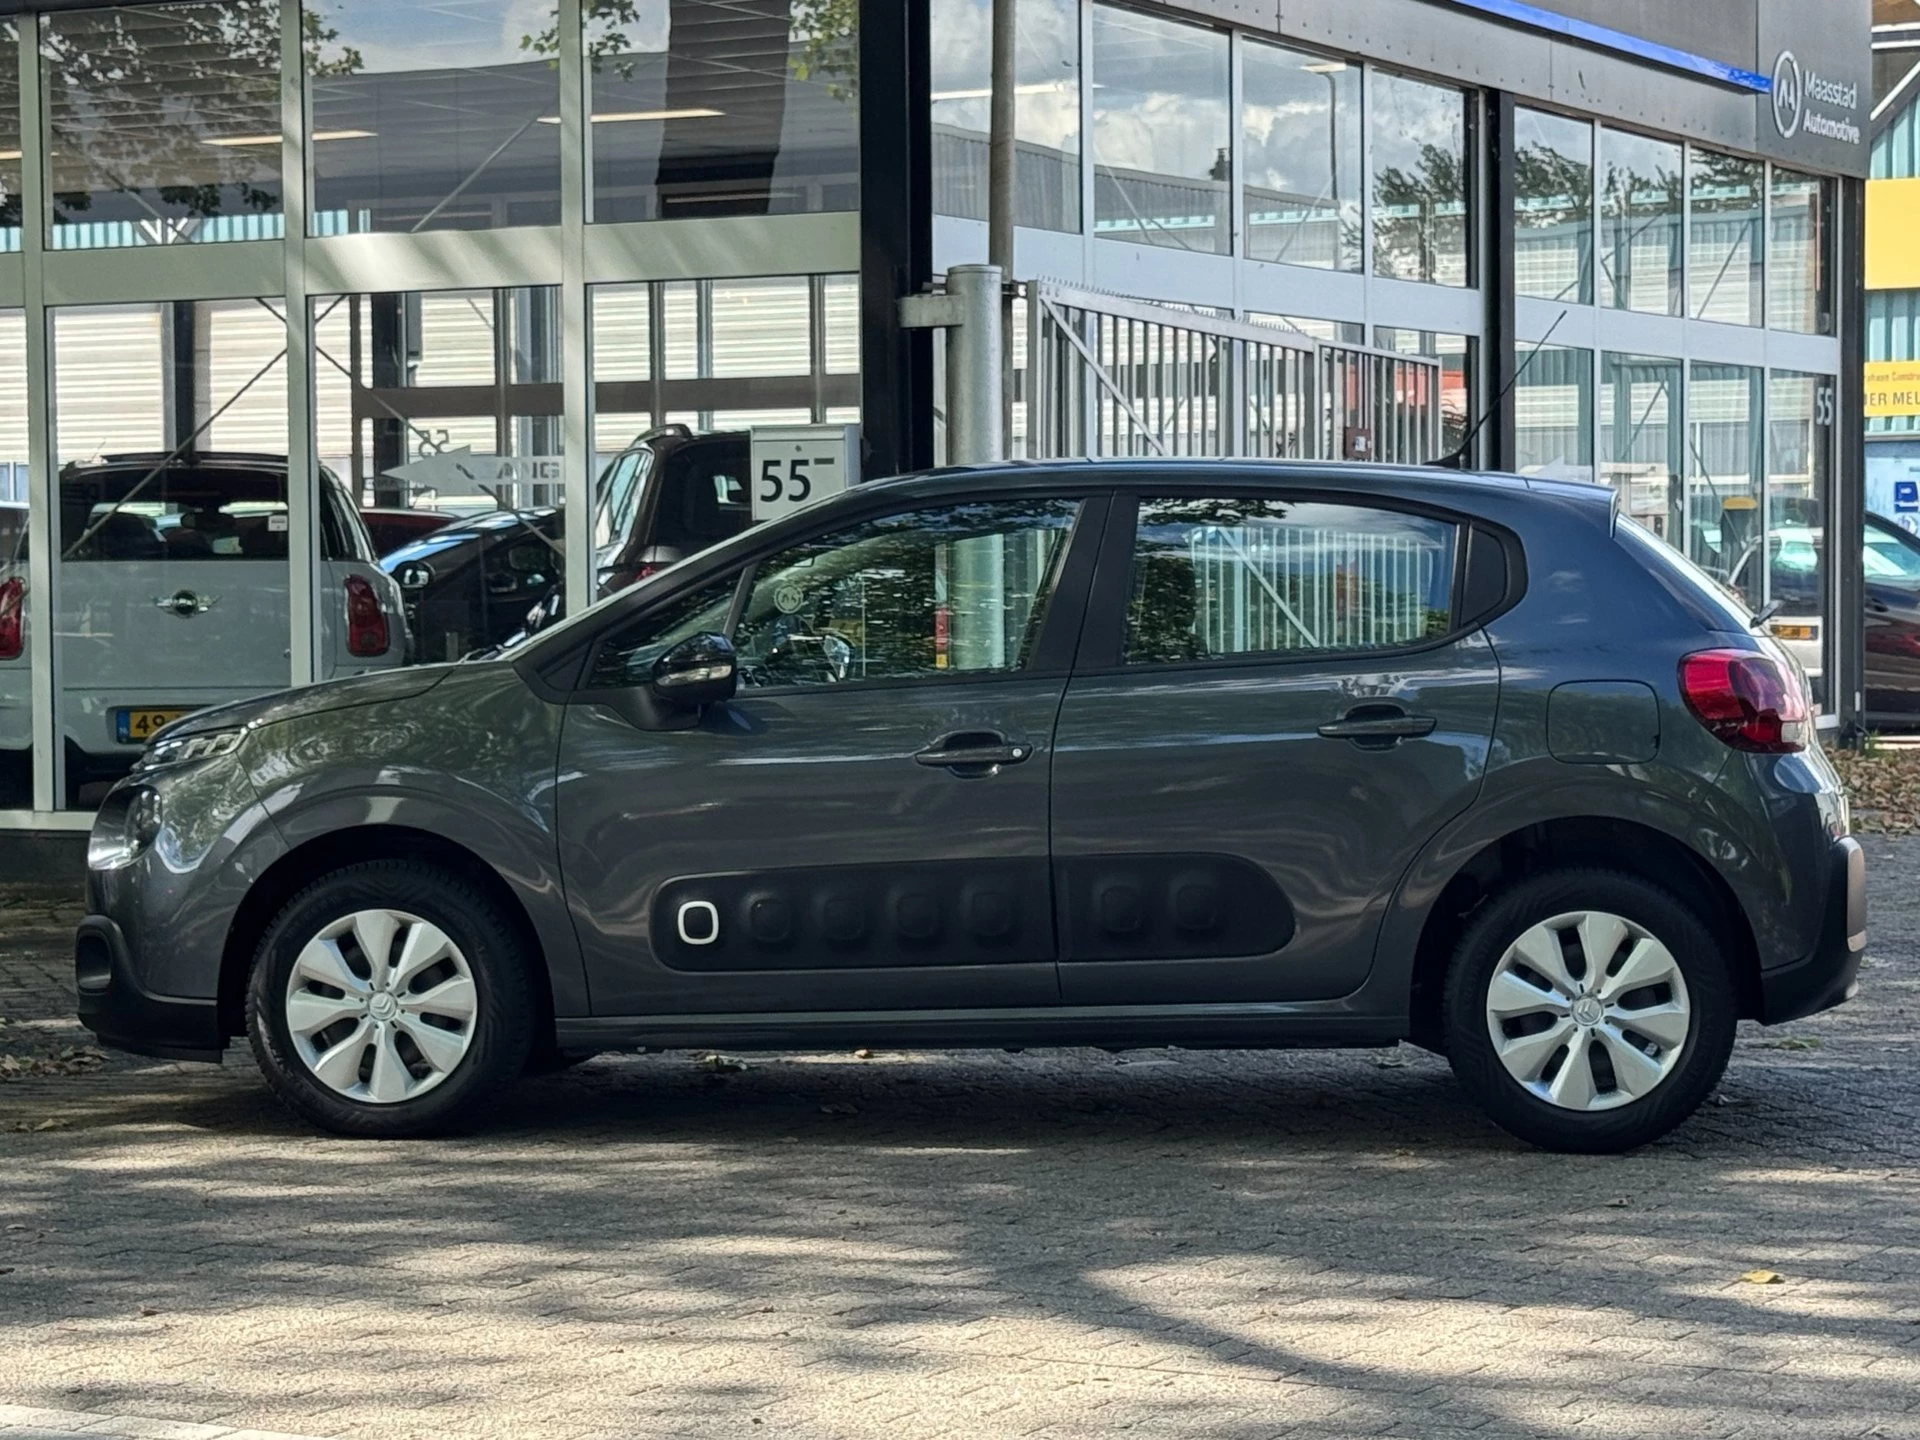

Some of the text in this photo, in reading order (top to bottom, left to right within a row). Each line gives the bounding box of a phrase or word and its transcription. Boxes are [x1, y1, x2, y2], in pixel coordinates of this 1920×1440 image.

[1804, 70, 1857, 109] Maasstad
[1803, 109, 1860, 144] Automotive
[1816, 387, 1833, 426] 55
[760, 459, 811, 502] 55
